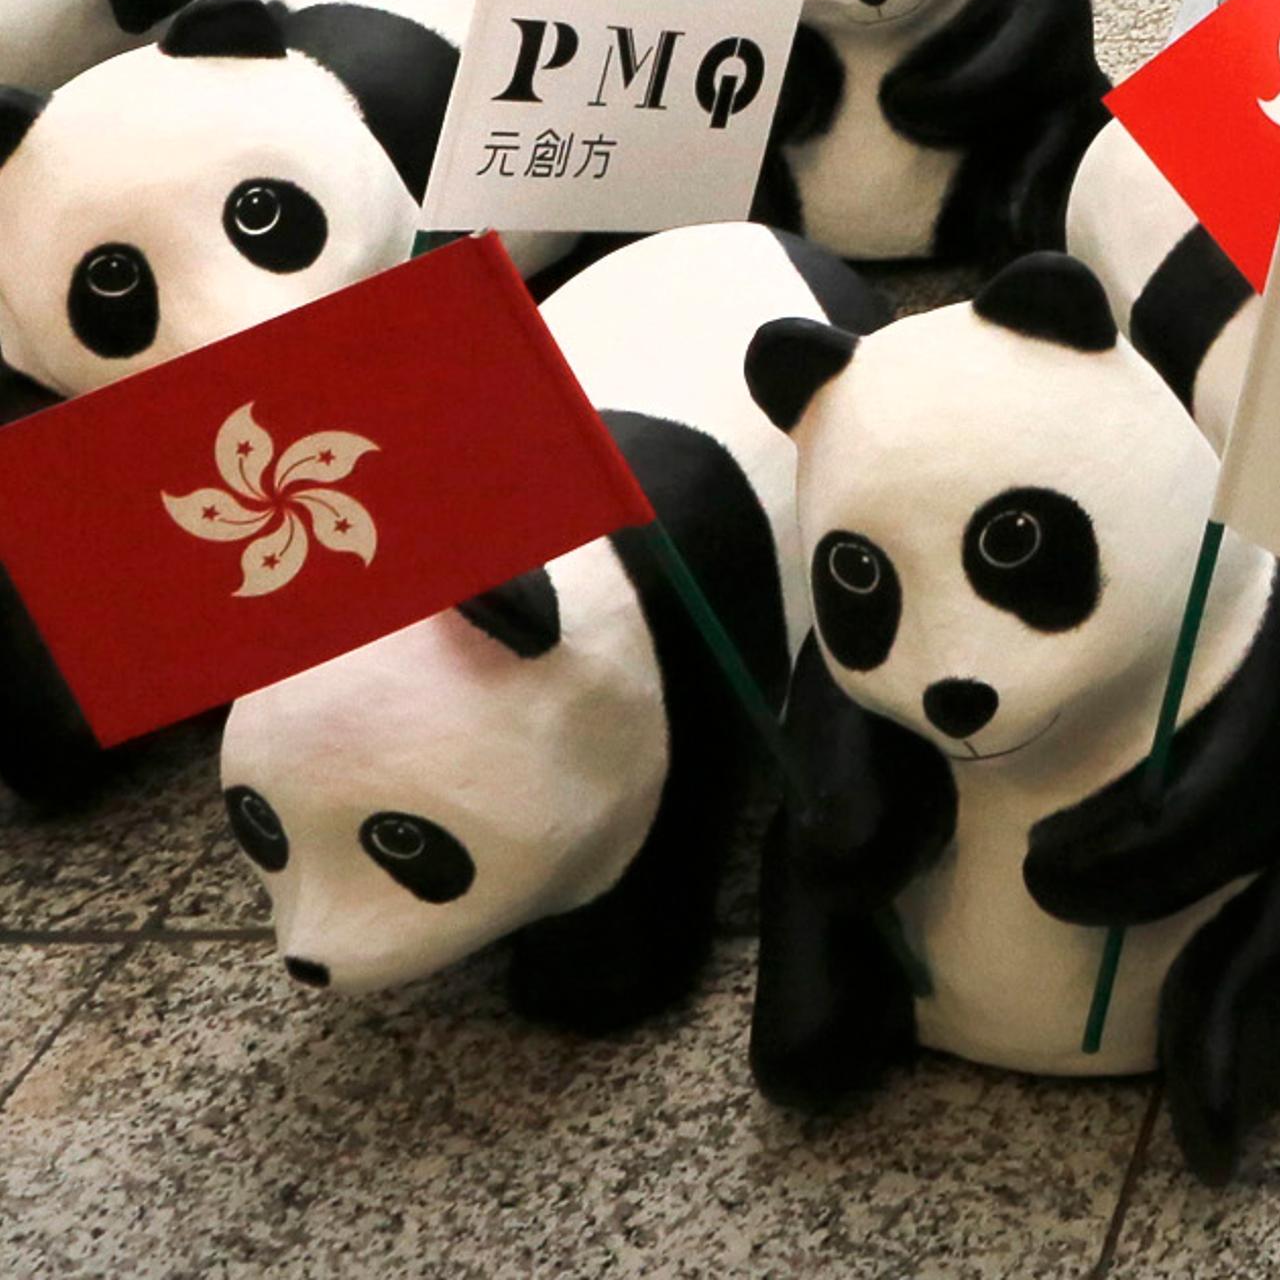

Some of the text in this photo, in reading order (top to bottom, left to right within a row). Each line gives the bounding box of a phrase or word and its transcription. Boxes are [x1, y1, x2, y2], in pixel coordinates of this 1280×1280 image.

[490, 17, 765, 129] PMQ
[476, 128, 617, 179] 元創方
